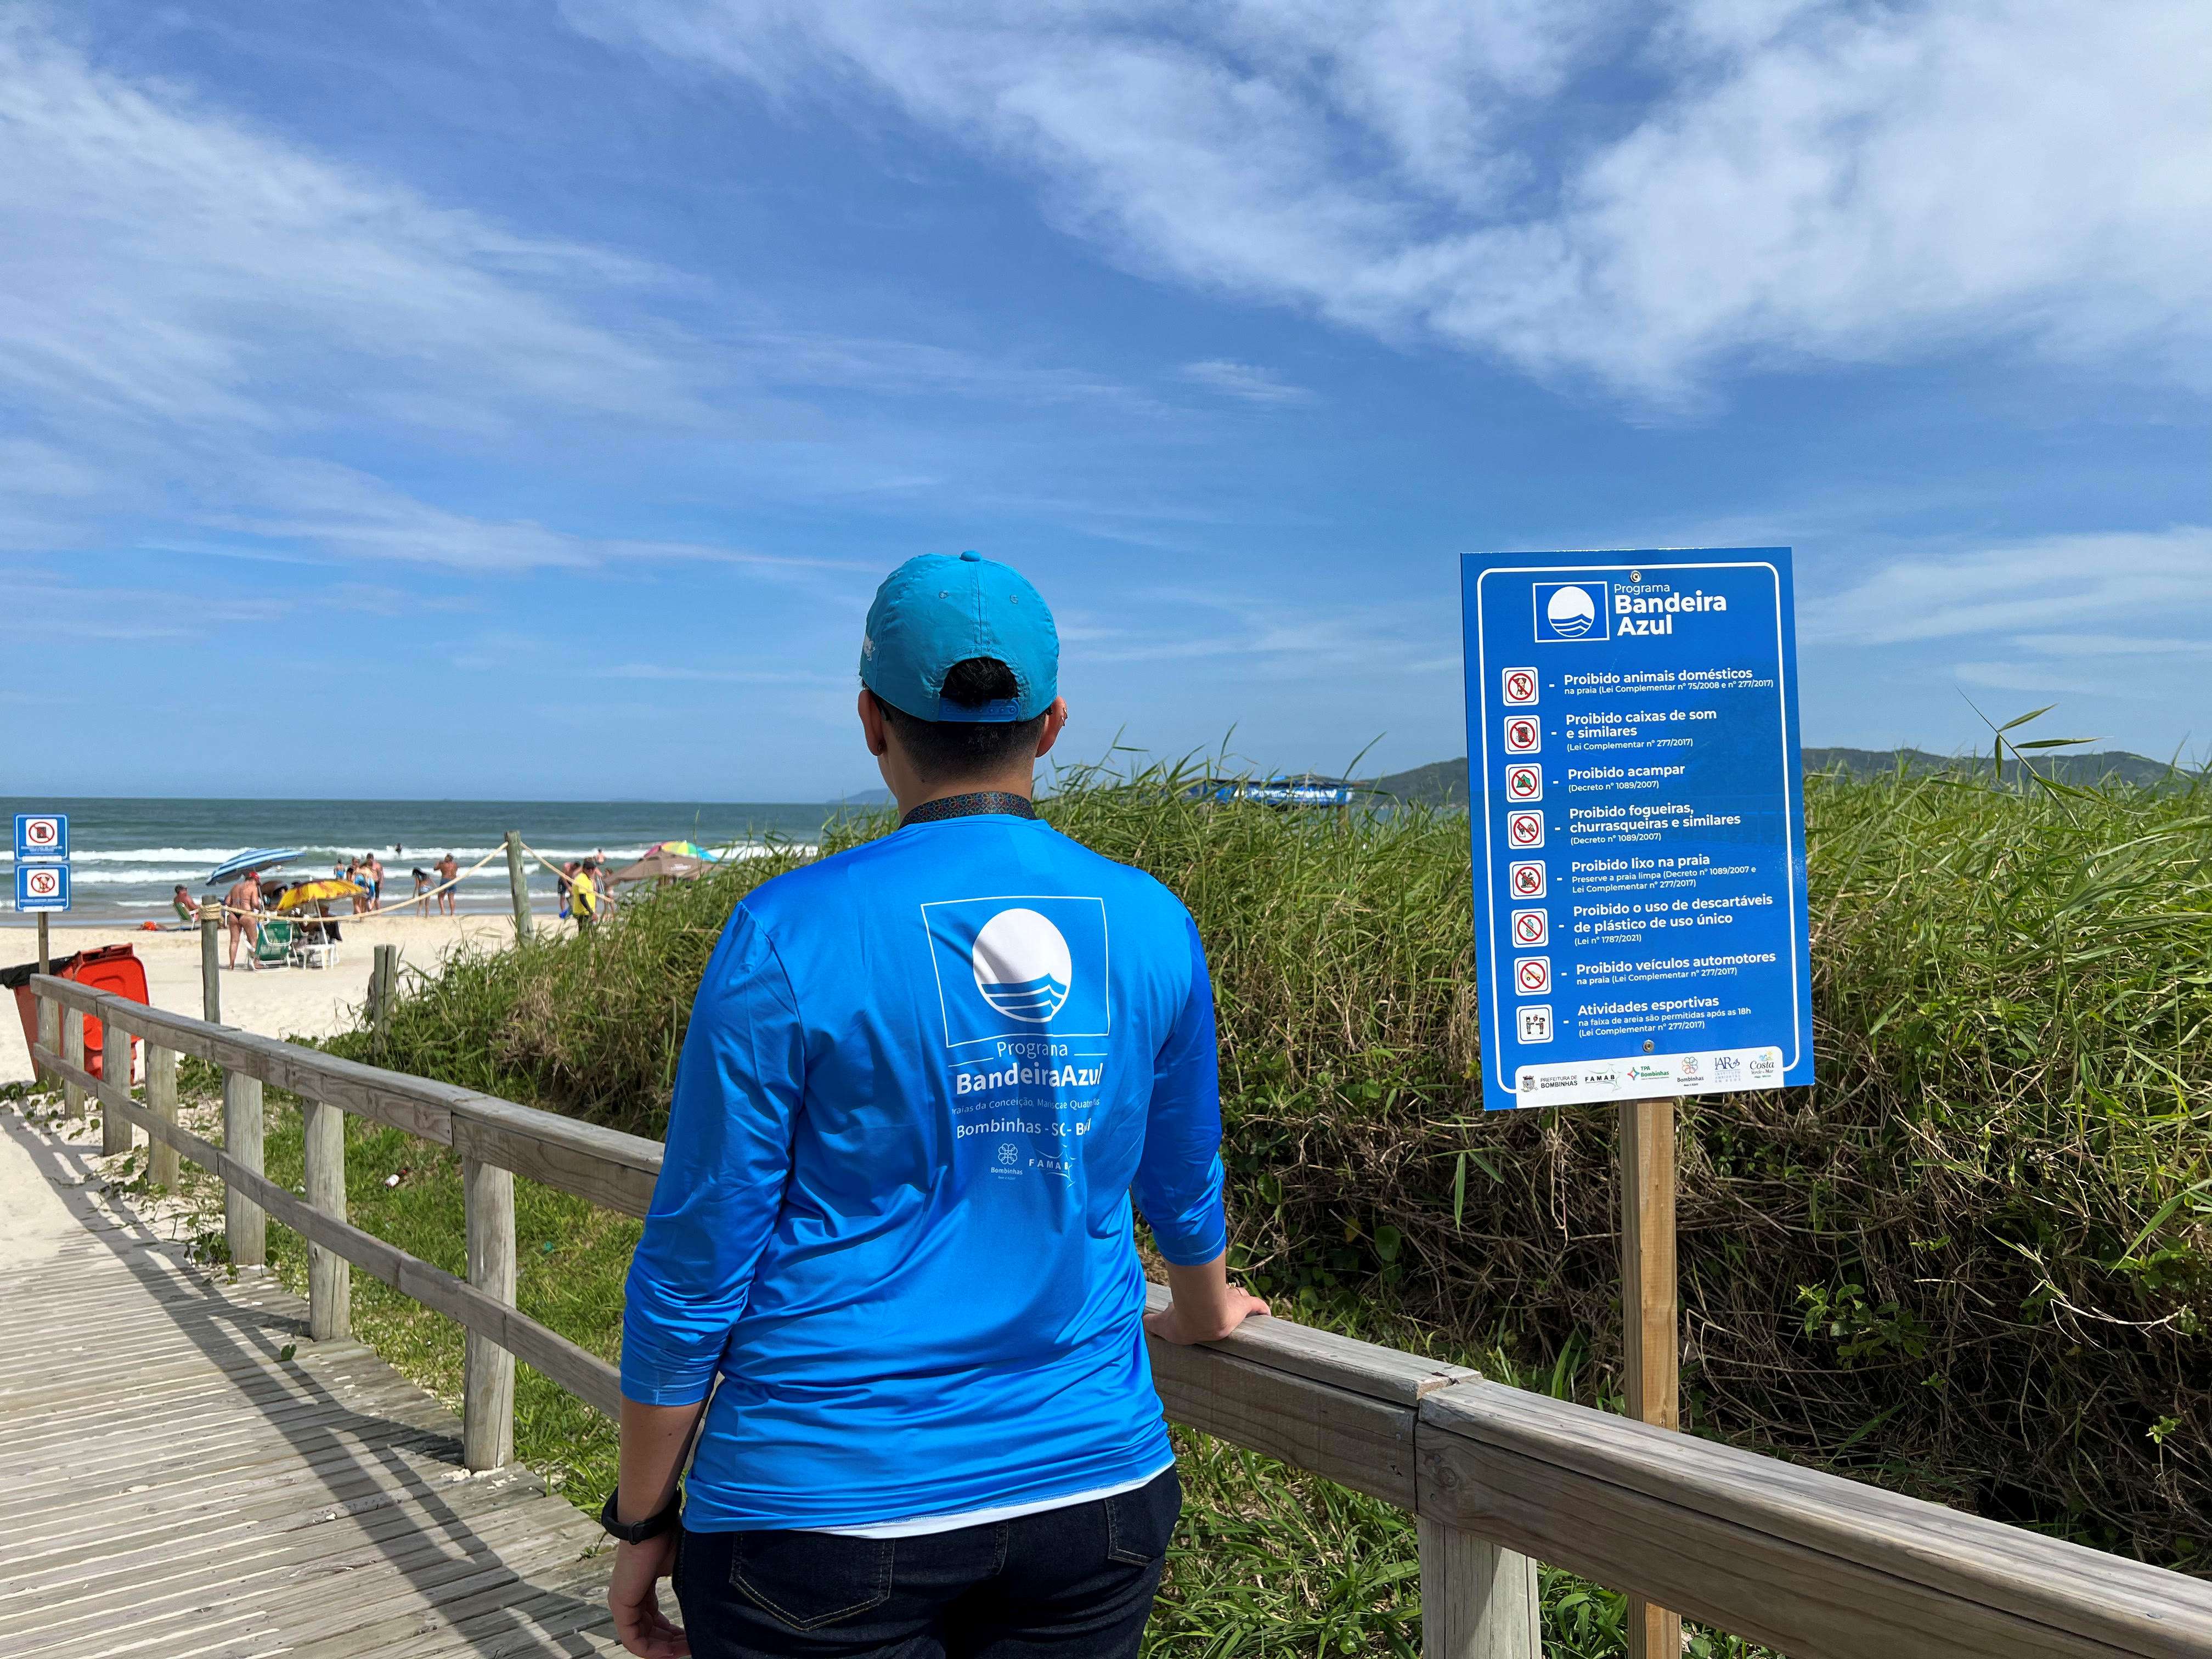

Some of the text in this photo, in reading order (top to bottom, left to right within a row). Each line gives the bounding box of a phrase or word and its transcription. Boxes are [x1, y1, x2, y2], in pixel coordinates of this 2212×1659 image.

[1615, 584, 1670, 595] Programa
[1615, 590, 1726, 613] Bandeira
[1617, 614, 1672, 636] Azul
[1565, 668, 1752, 685] Proibido animais domésticos
[1577, 686, 1596, 695] praia
[1599, 686, 1613, 694] (Lei
[1616, 685, 1675, 693] Complementar
[1688, 681, 1719, 690] 75/2008
[1566, 710, 1717, 725] Proibido caixas de som
[1566, 726, 1637, 738] e similares
[1567, 743, 1581, 752] (Lei
[1584, 742, 1644, 751] Complementar
[1657, 738, 1692, 747] 277/2017)
[1568, 766, 1685, 780] Proibido acampar
[1569, 784, 1604, 793] (Decreto
[1616, 781, 1658, 789] 1089/2007)
[1570, 803, 1694, 819] Proibido fogueiras,
[1570, 820, 1668, 833] churrasqueiras
[1683, 814, 1741, 827] similares
[1571, 837, 1605, 845] (Decreto
[1618, 833, 1661, 842] 1089/2007)
[1572, 854, 1709, 872] Proibido lixo na praia
[1617, 873, 1636, 882] praia
[1663, 870, 1697, 879] (Decreto
[1709, 866, 1749, 874] 1089/2007
[1587, 883, 1647, 893] Complementar
[1660, 879, 1696, 888] 277/2017)
[1574, 903, 1629, 916] Proibido
[1645, 903, 1668, 912] uso
[1672, 900, 1688, 910] de
[1692, 894, 1773, 909] descartáveis
[1575, 913, 1733, 934] de plástico de uso único
[1575, 937, 1589, 946] (Lei
[1601, 934, 1641, 943] 1787/2021)
[1577, 953, 1776, 974] Proibido veículos automotores
[1589, 976, 1610, 985] praia
[1612, 974, 1626, 984] (Lei
[1628, 972, 1689, 981] Complementar
[1701, 967, 1737, 976] 277/2017)
[1578, 996, 1719, 1017] Atividades esportivas
[1624, 1015, 1643, 1023] areia
[1662, 1011, 1705, 1022] permitidas
[1707, 1009, 1725, 1018] após
[1579, 1029, 1593, 1037] (Lei
[1595, 1026, 1656, 1035] Complementar
[1668, 1020, 1705, 1030] 277/2017)
[1750, 1060, 1774, 1070] Costa
[1541, 1081, 1578, 1089] BOMBINHAS
[1585, 1074, 1615, 1082] FAMAB
[975, 1102, 986, 1110] da
[957, 1117, 1041, 1139] Bombinhas
[990, 1166, 1023, 1175] Bombinhas
